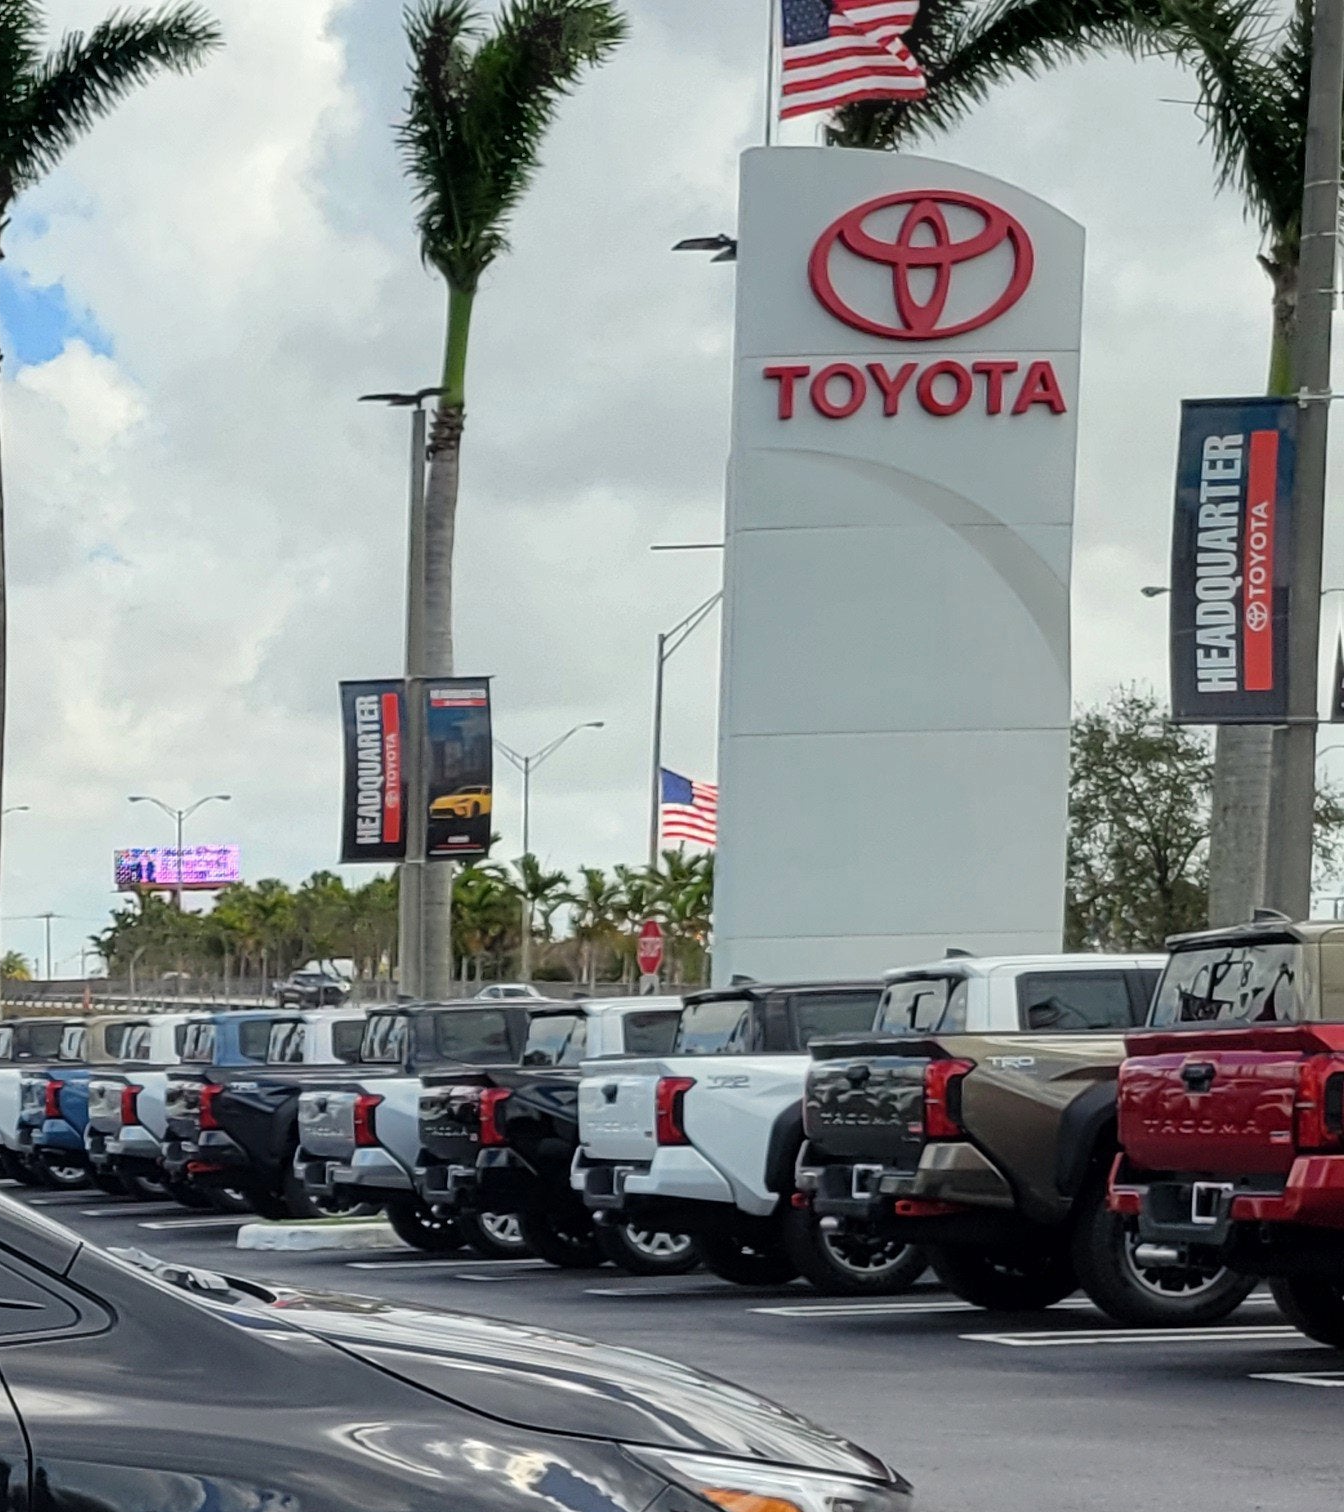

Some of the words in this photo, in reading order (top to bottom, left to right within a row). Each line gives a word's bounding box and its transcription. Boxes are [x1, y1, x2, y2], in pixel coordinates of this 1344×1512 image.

[764, 360, 1067, 420] TOYOTA
[1195, 433, 1245, 693] HEADQUARTER
[1248, 501, 1271, 597] TOYOTA
[355, 694, 385, 844] HEADQUARTER
[385, 733, 399, 787] TOYOTA
[820, 1112, 902, 1126] TACOMA
[1142, 1119, 1262, 1134] TACOMA
